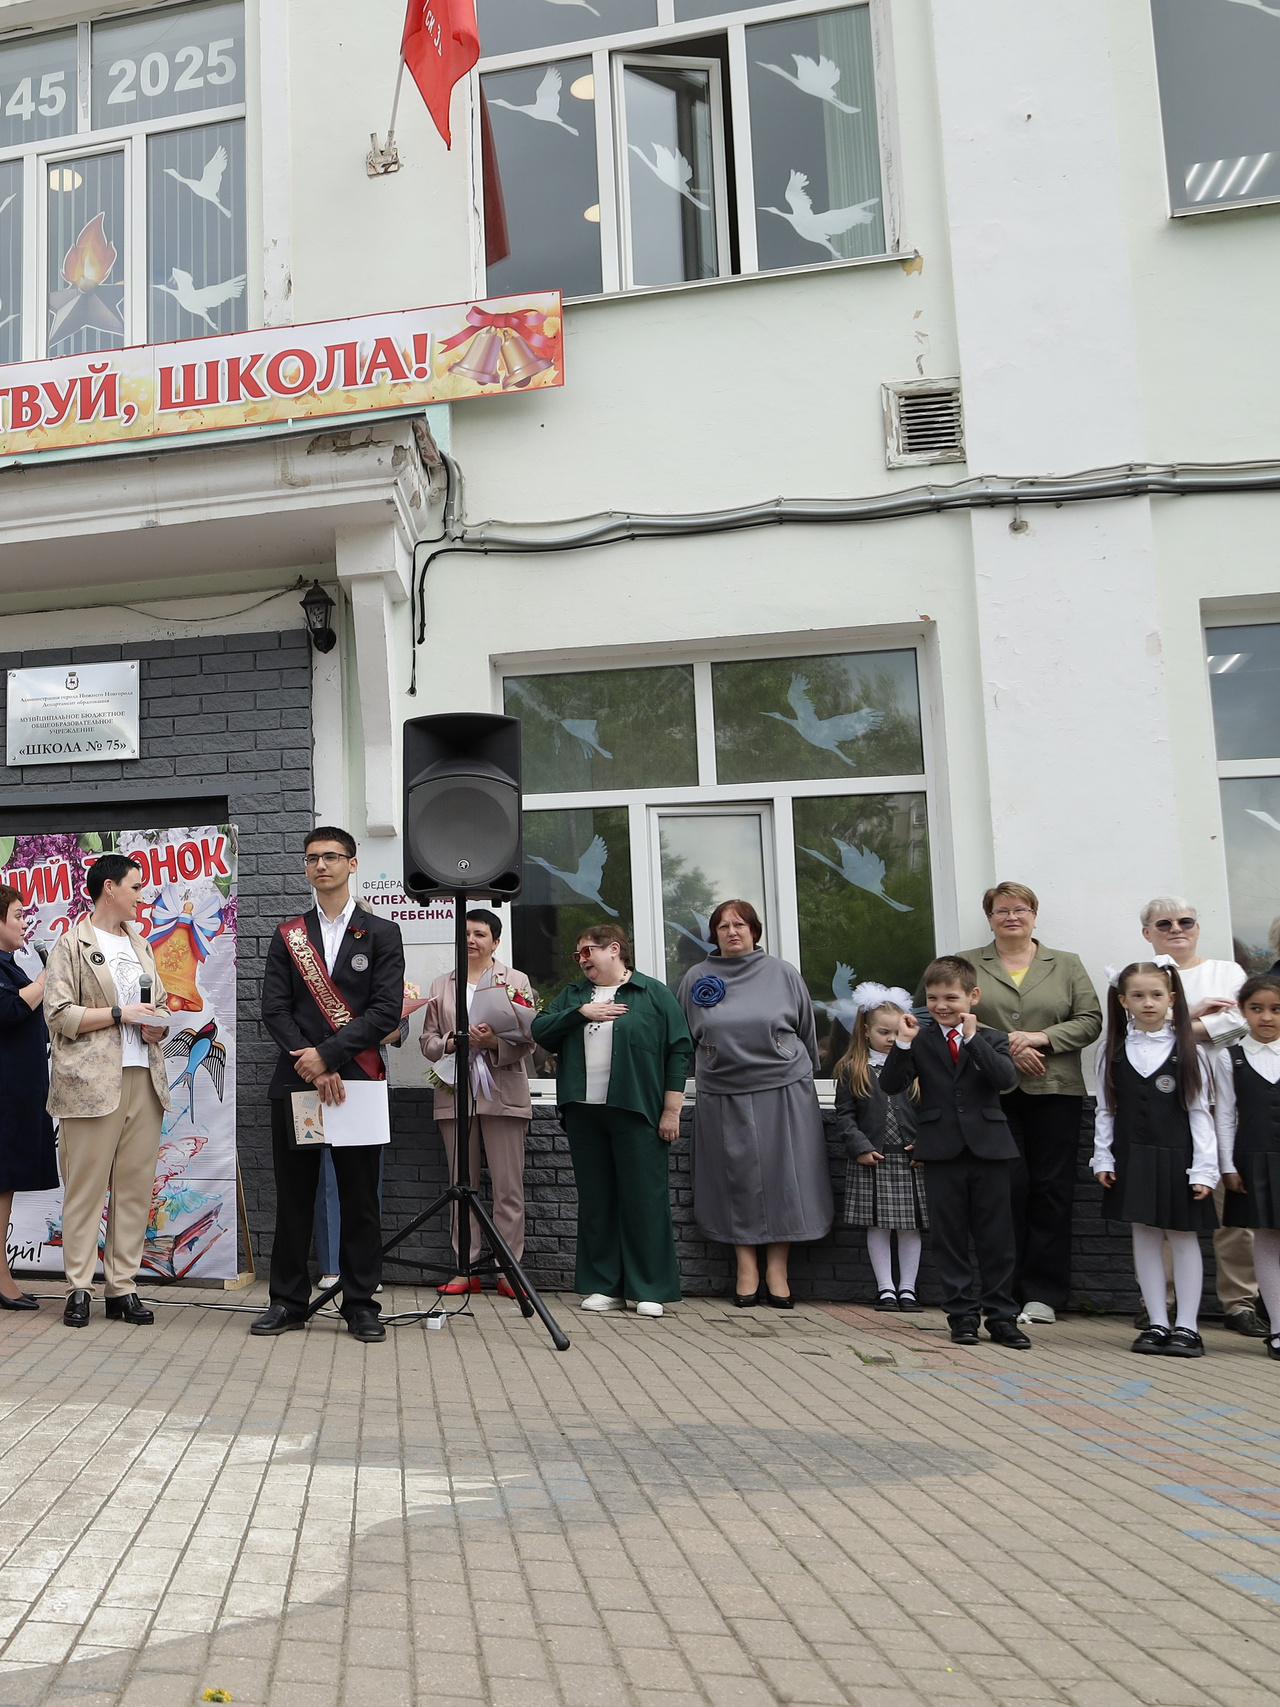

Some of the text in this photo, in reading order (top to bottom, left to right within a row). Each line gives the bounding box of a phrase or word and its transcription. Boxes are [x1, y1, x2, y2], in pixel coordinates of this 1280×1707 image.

[108, 38, 238, 104] 2025
[157, 333, 429, 413] ШКОЛА!
[81, 711, 126, 720] БЮДЖЕТНОЕ
[31, 719, 114, 729] ОБЩЕОБРАЗОВАТЕЛЬНОЕ
[49, 727, 95, 735] УЧРЕЖДЕНИЕ
[19, 739, 127, 755] «ШКОЛА № 75»
[391, 909, 454, 920] РЕБЕНКА
